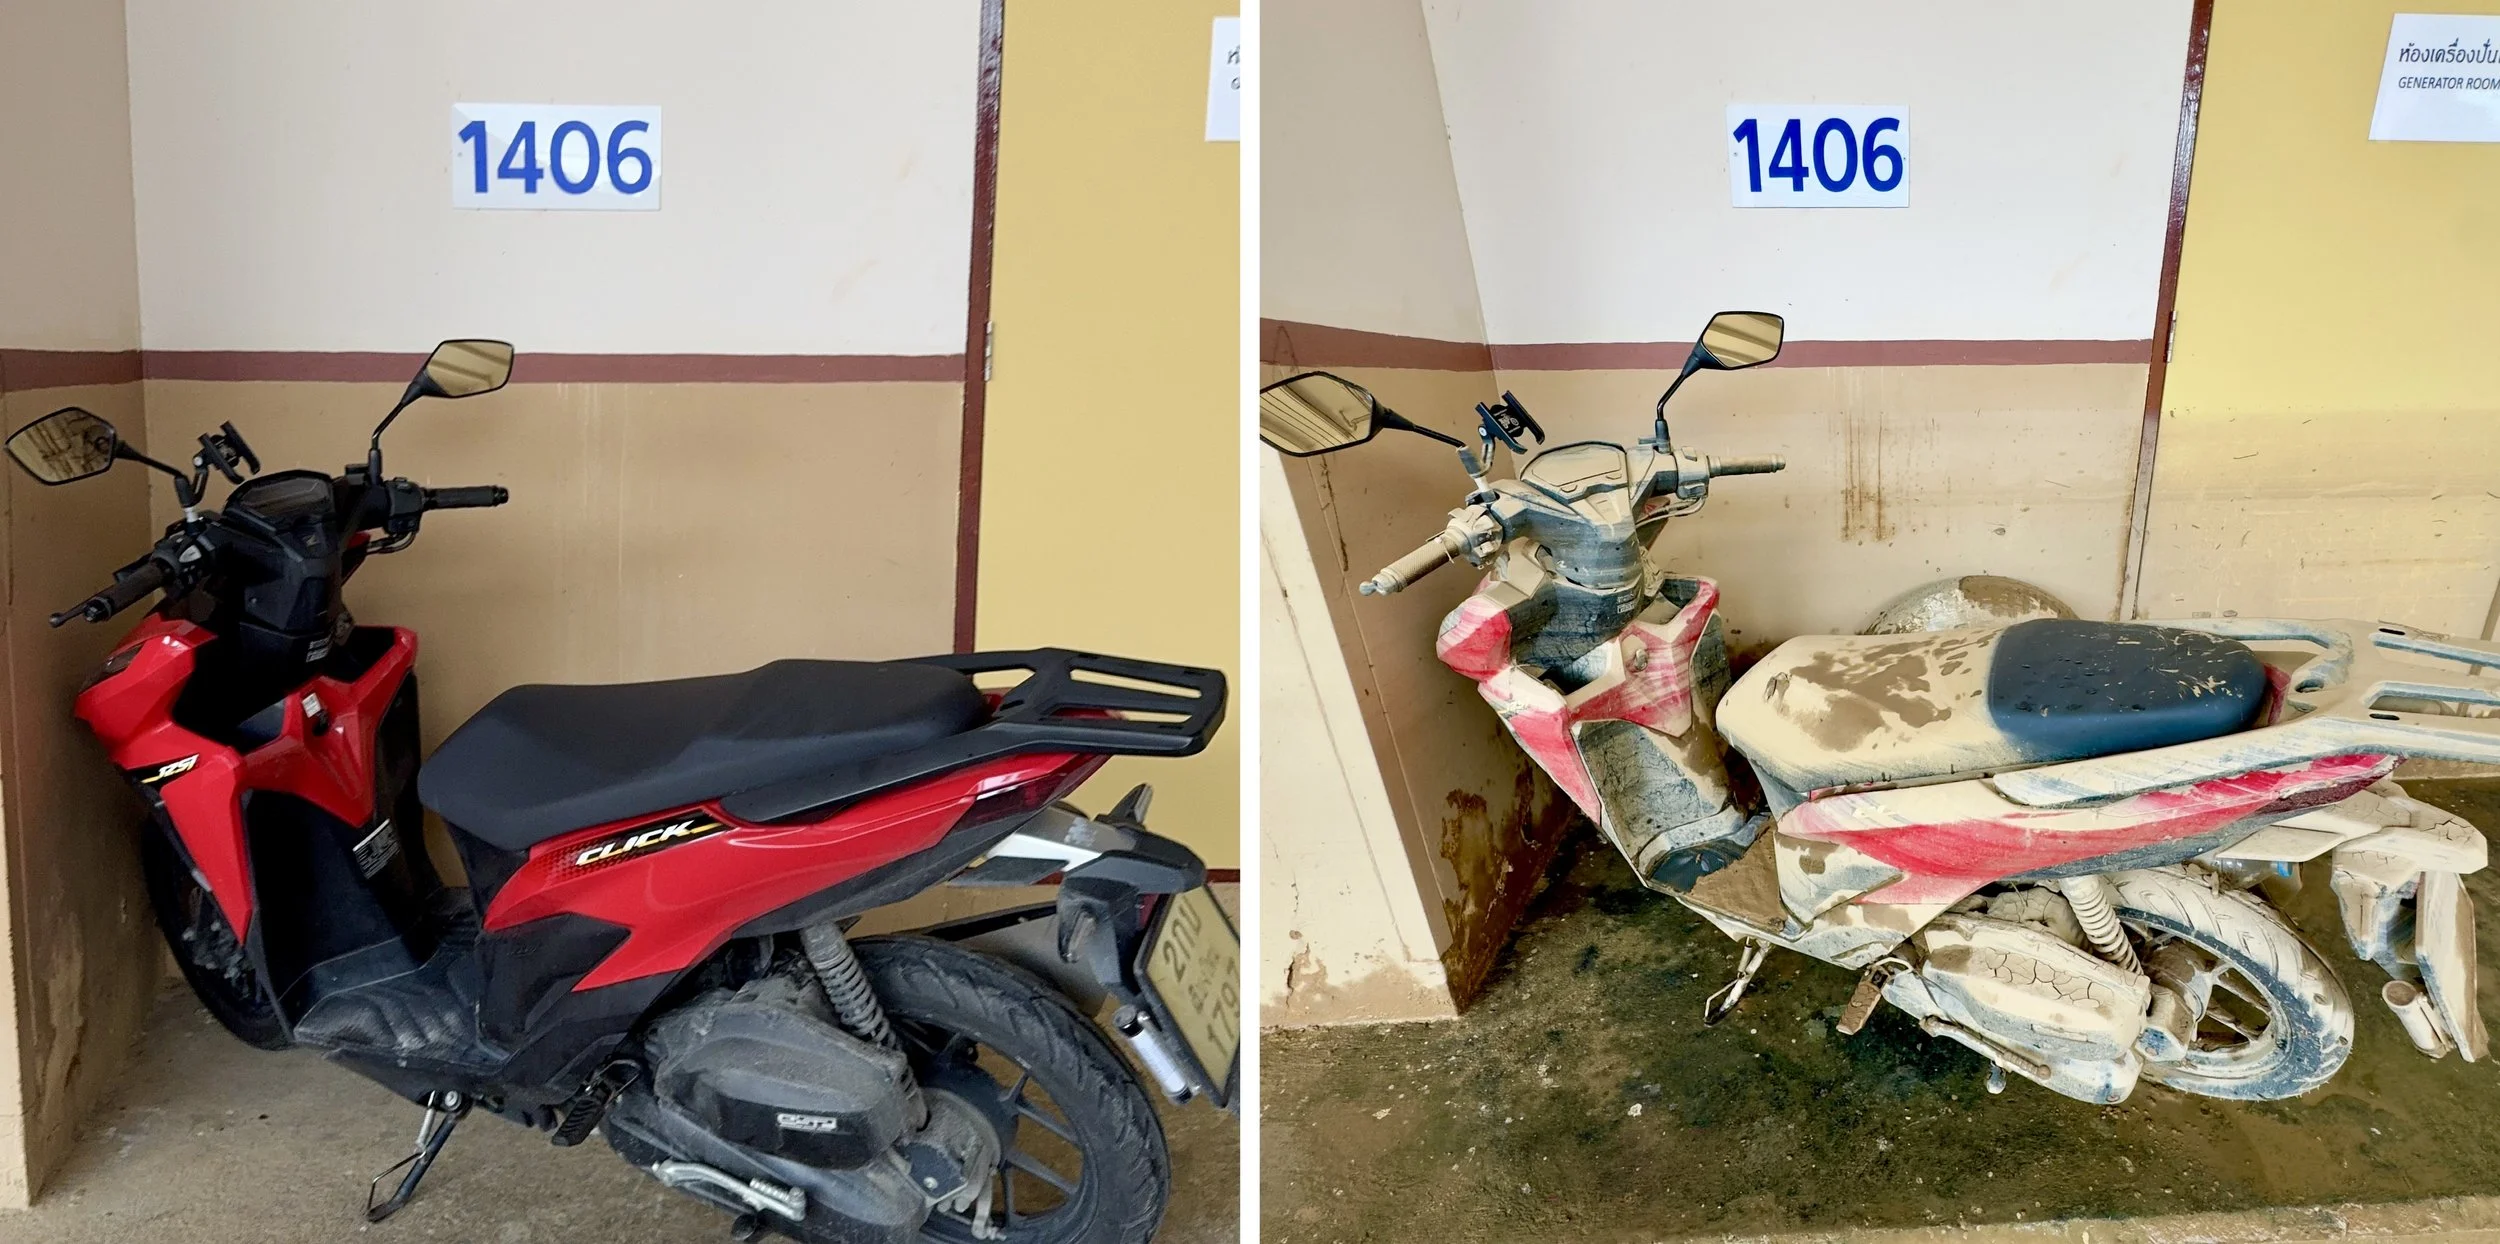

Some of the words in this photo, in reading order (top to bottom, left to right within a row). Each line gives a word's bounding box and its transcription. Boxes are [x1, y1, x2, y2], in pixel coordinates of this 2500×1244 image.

[2399, 38, 2500, 64] ห้องเครื่องปั่น
[2398, 76, 2464, 90] GENERATOR
[2466, 77, 2500, 91] ROOM
[458, 120, 653, 195] 1406
[1733, 117, 1903, 193] 1406
[575, 820, 695, 867] CLICK
